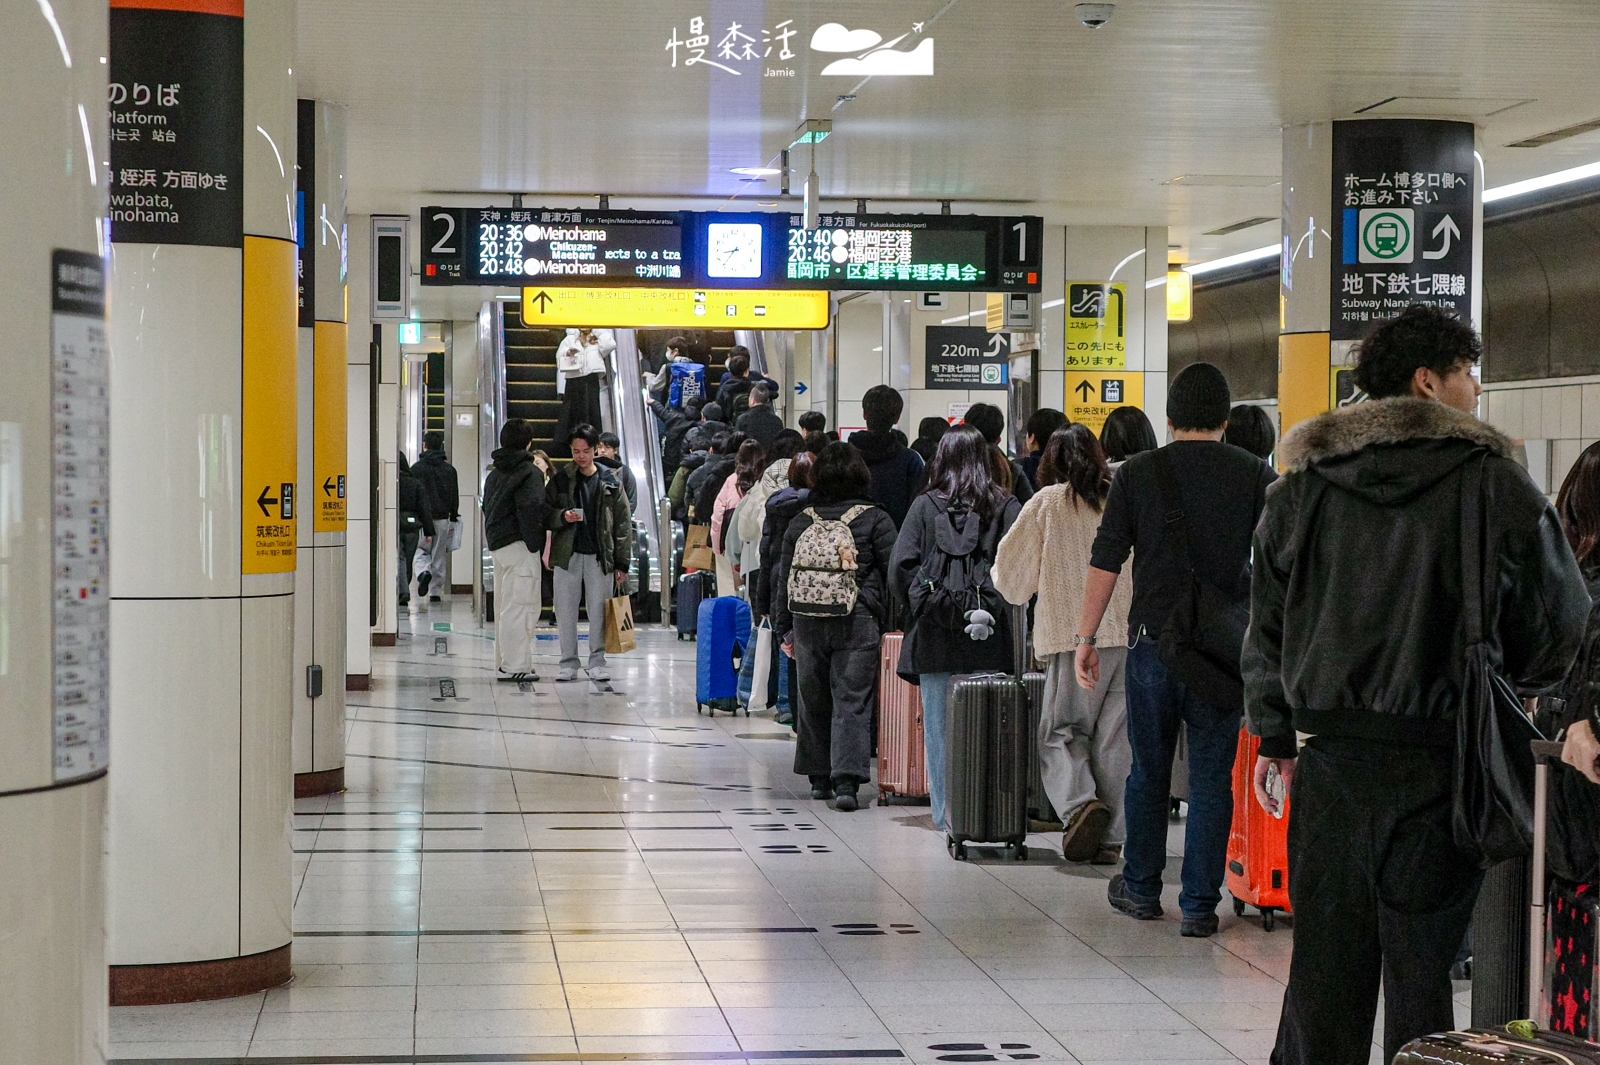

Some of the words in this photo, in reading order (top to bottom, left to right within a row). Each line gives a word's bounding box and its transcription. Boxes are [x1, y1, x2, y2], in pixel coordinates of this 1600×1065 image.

[152, 129, 176, 142] 站台
[1344, 172, 1466, 189] ホーム博多口側へ
[1344, 189, 1438, 206] お進み下さい
[431, 213, 456, 254] 2
[480, 224, 523, 241] 20:36
[540, 225, 606, 241] Meinohama
[788, 229, 831, 246] 20:40
[848, 229, 913, 247] 福岡空港
[480, 241, 523, 258] 20:42
[1012, 222, 1027, 262] 1
[635, 249, 647, 259] to
[651, 250, 659, 259] a
[788, 246, 831, 263] 20:46
[848, 246, 913, 264] 福岡空港
[480, 258, 523, 275] 20:48
[540, 259, 606, 275] Meinohama
[1003, 271, 1023, 279] のりば
[1342, 273, 1466, 296] 地下鉄七隈線
[1342, 299, 1380, 309] Subway
[1342, 312, 1368, 321] 지하철
[941, 345, 980, 357] 220m
[1066, 341, 1124, 351] この先にも
[1066, 356, 1124, 366] あります。
